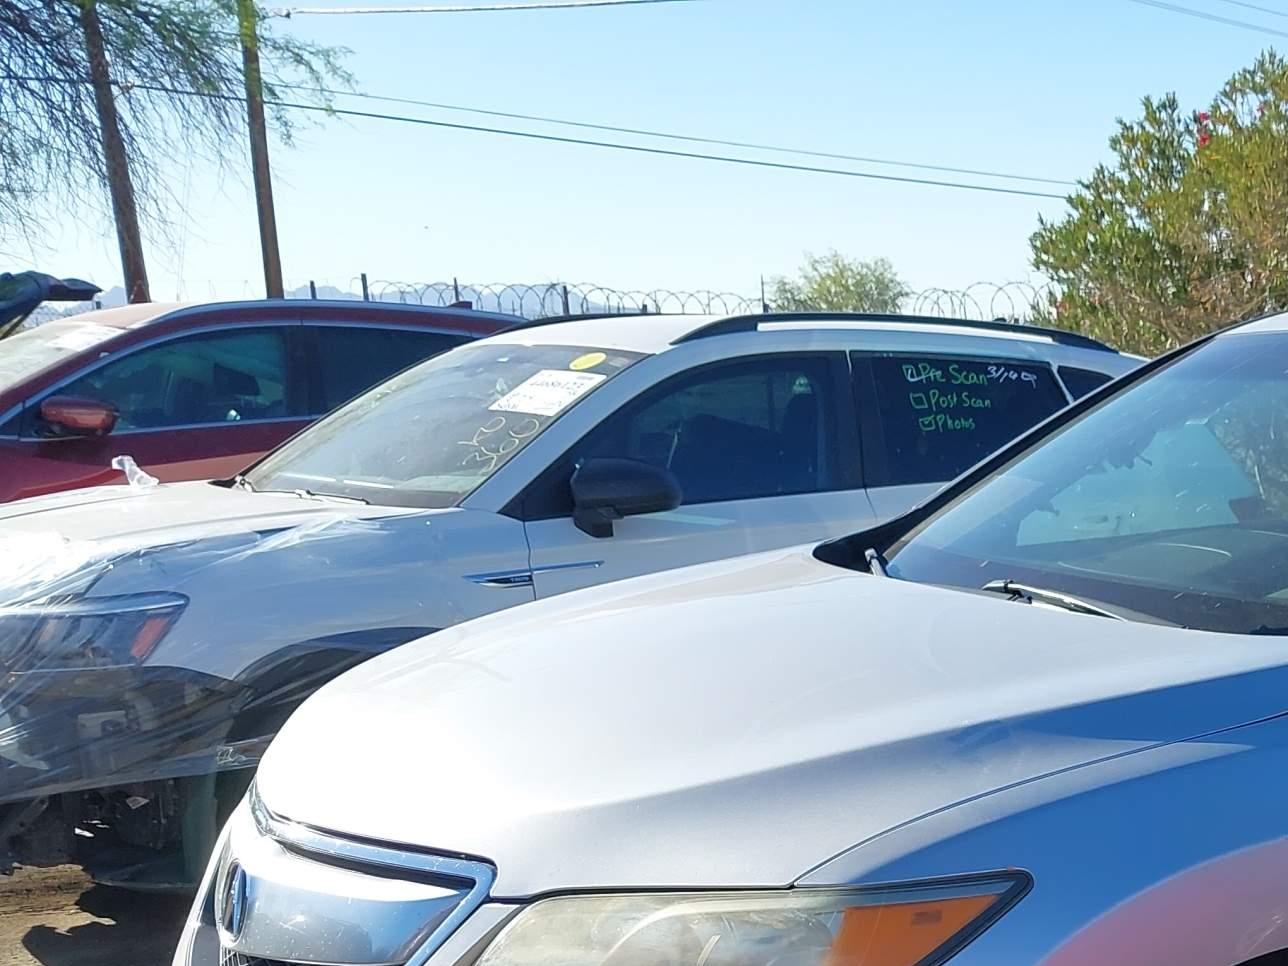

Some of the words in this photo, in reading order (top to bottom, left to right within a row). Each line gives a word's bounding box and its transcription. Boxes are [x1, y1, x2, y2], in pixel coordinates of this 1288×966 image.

[919, 363, 947, 384] Pre
[949, 364, 989, 386] Scan
[930, 389, 959, 411] Post
[962, 391, 992, 409] Scan
[936, 414, 976, 432] Photos
